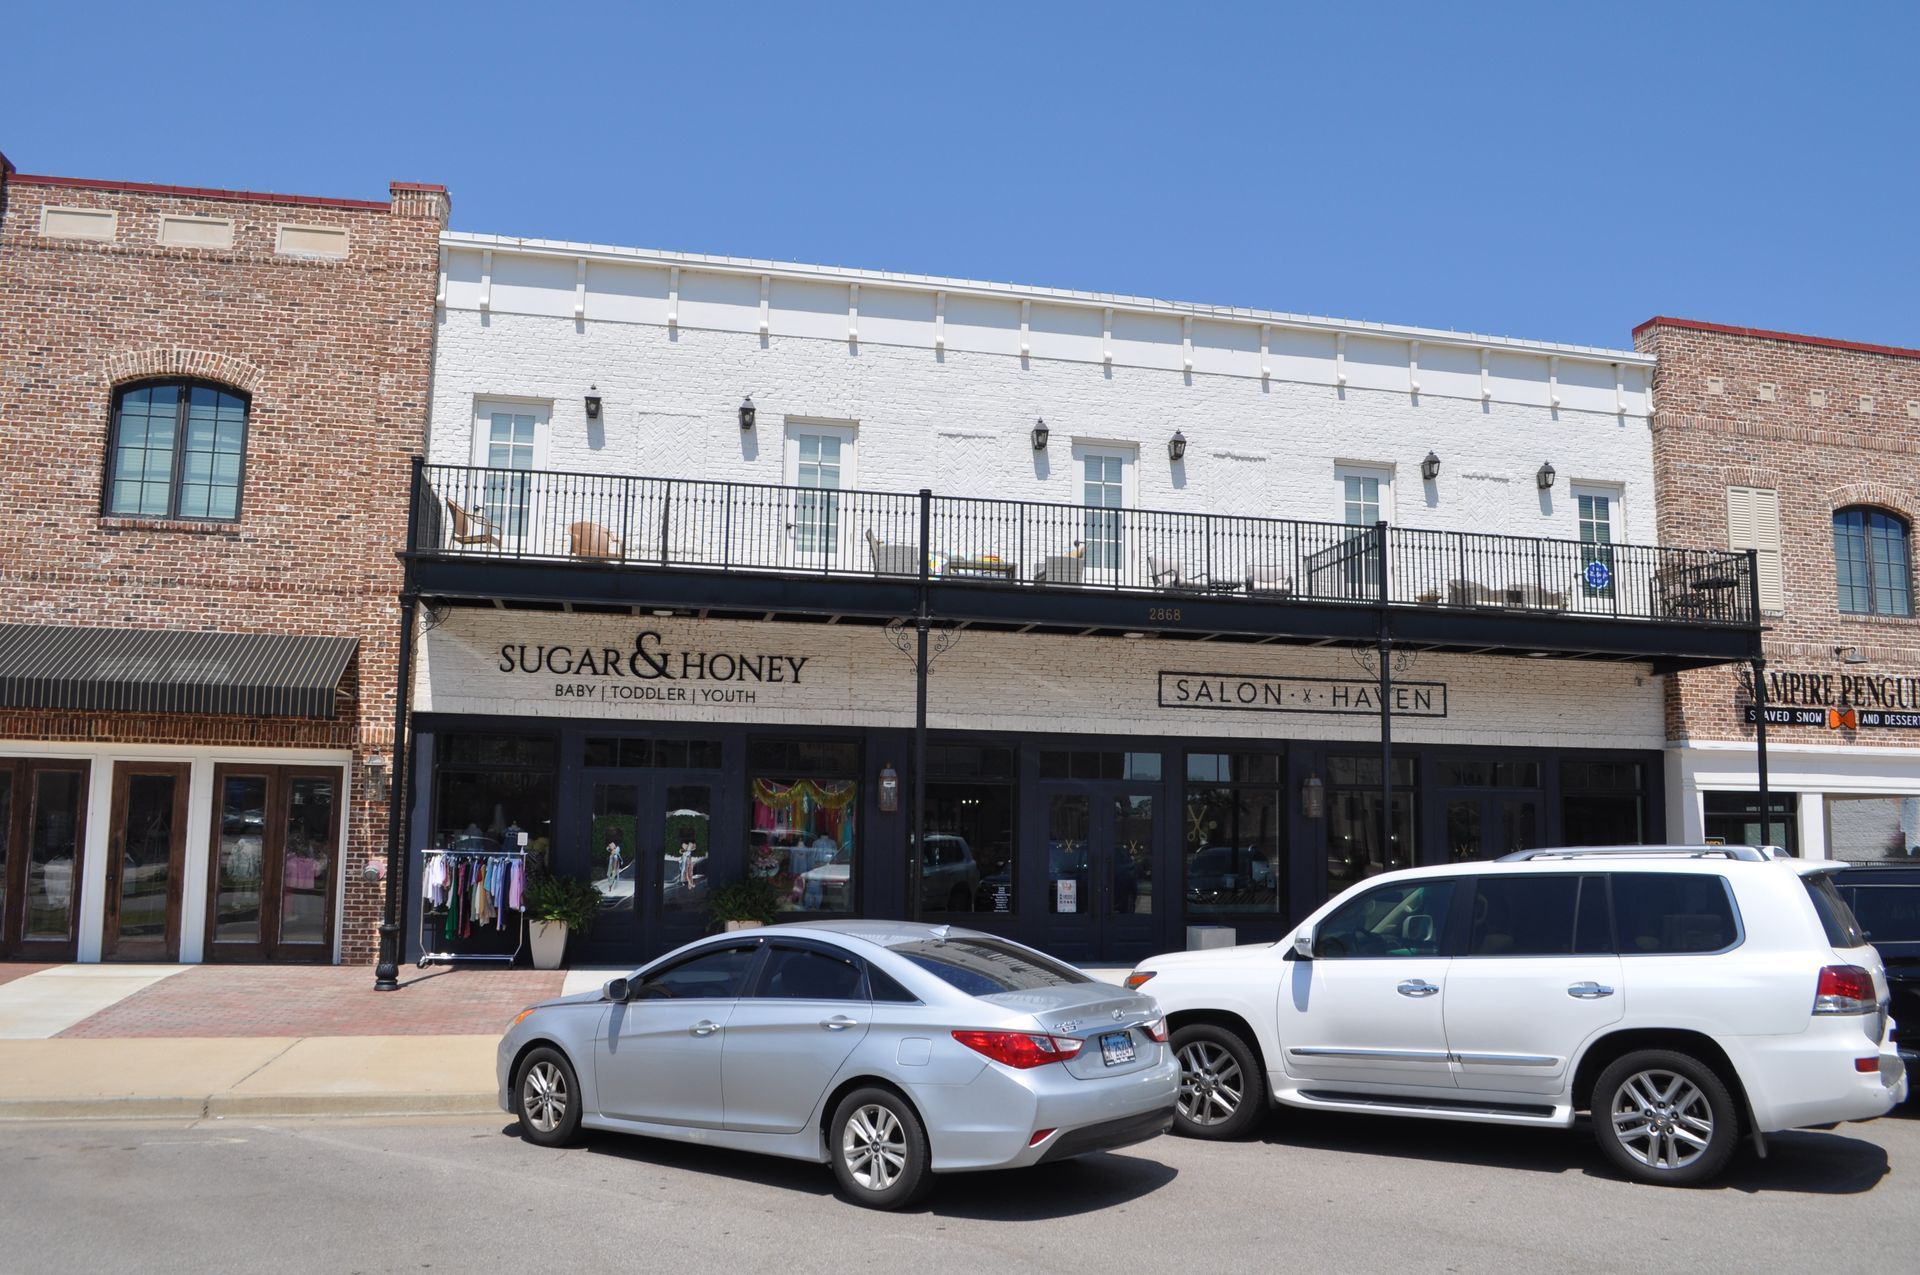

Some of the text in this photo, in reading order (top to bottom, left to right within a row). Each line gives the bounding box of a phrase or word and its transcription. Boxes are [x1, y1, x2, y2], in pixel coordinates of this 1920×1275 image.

[1150, 608, 1181, 621] 2868
[499, 631, 809, 683] SUGAR & HONEY
[555, 684, 756, 703] BABY TODDLER YOUTH
[1176, 679, 1281, 705] SALON
[1841, 675, 1920, 708] PENGUI
[1749, 709, 1790, 722] SAVED
[1796, 711, 1822, 723] SNOW
[1862, 713, 1880, 725] AND
